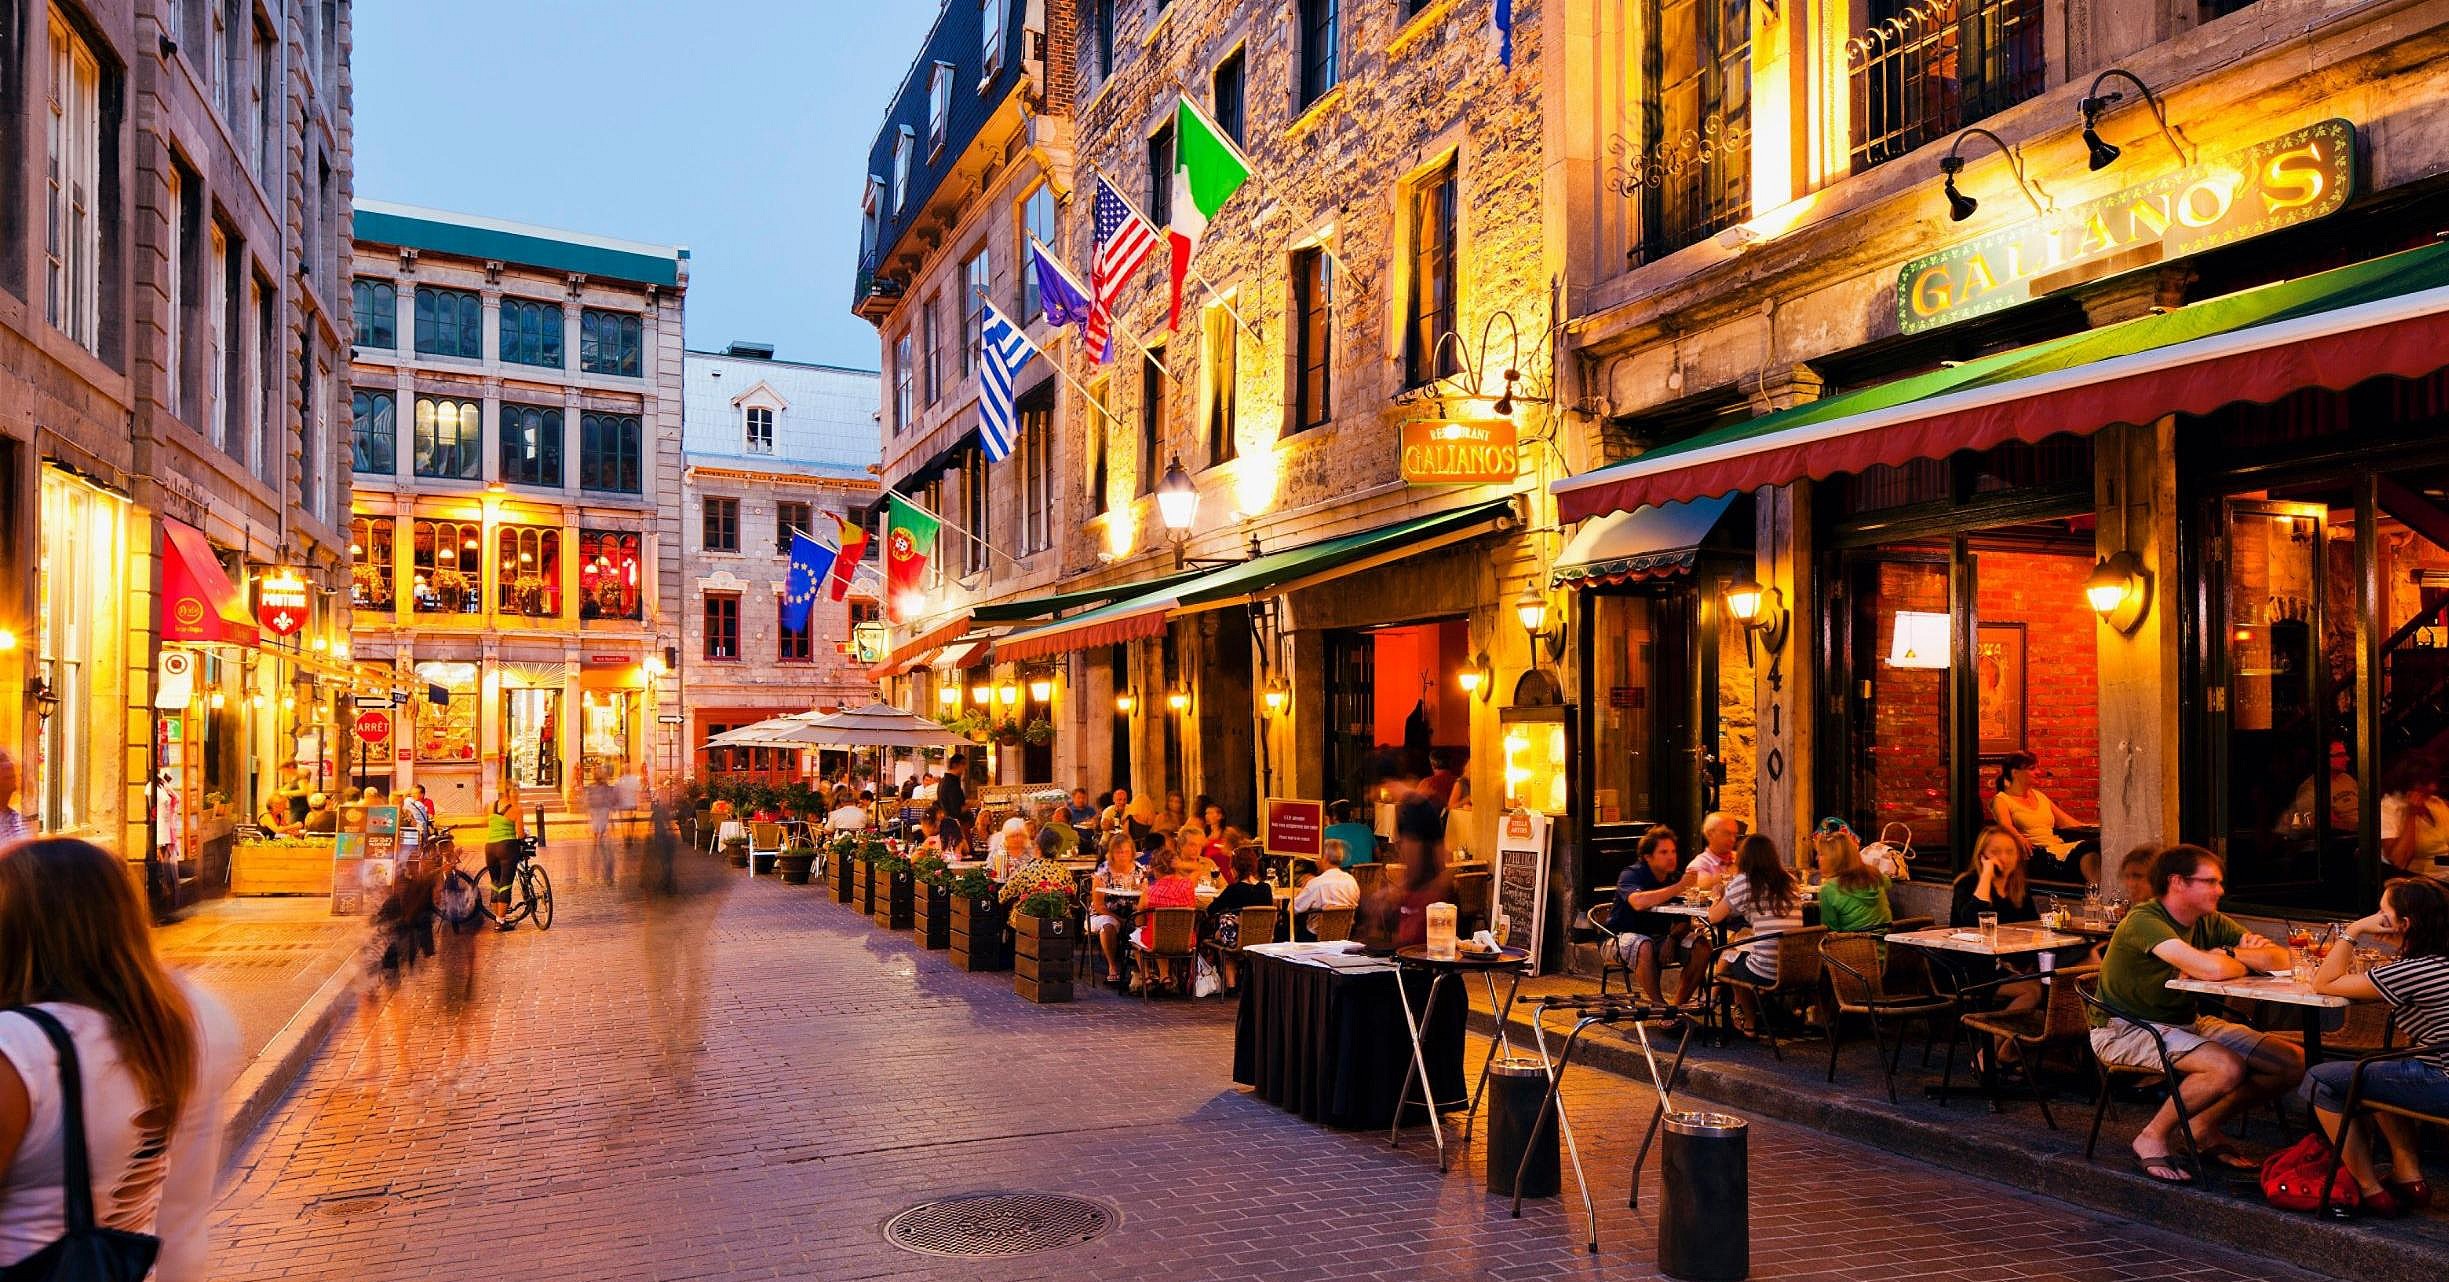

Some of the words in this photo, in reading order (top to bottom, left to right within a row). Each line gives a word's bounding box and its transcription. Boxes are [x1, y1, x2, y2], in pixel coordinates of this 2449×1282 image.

[1911, 142, 2324, 317] GALIANO'S
[1405, 444, 1517, 475] GALIANOS
[357, 721, 389, 733] ARRÊT
